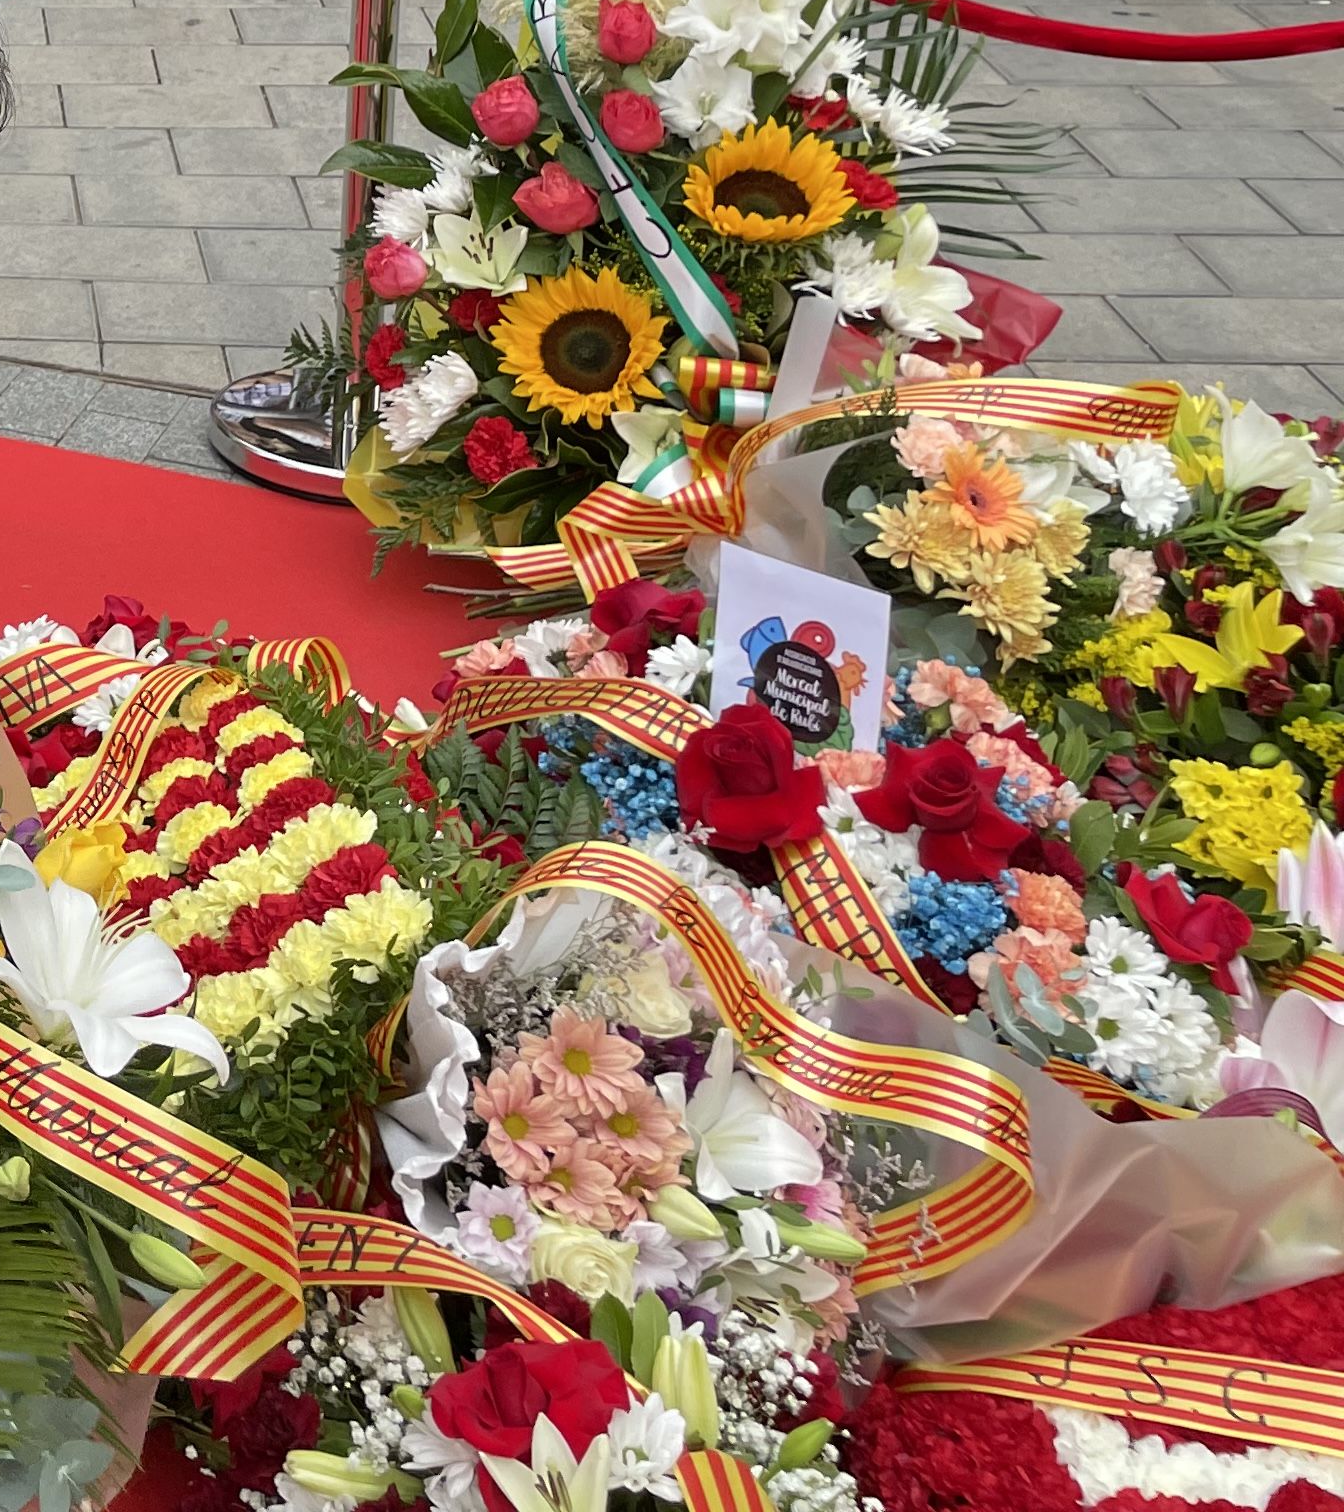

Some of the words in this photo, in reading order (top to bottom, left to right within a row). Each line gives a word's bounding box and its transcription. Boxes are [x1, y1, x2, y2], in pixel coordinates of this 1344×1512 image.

[773, 667, 822, 698] Mercat
[763, 680, 831, 717] Municipal
[771, 699, 788, 722] de
